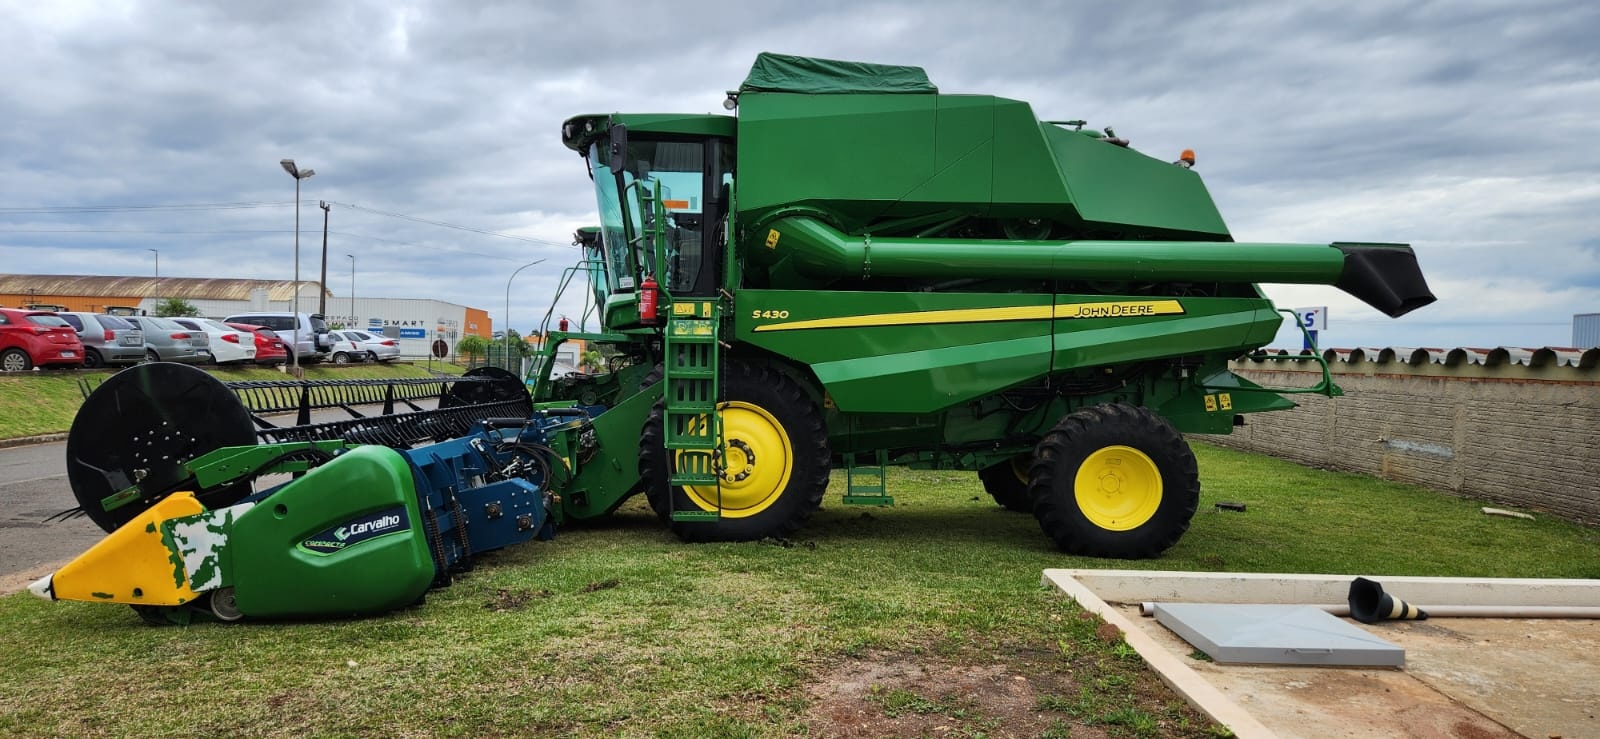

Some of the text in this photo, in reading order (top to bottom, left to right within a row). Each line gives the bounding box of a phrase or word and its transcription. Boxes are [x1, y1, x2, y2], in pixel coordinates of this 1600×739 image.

[1075, 305, 1154, 316] JOHN DEERE
[350, 515, 400, 535] Carvalho
